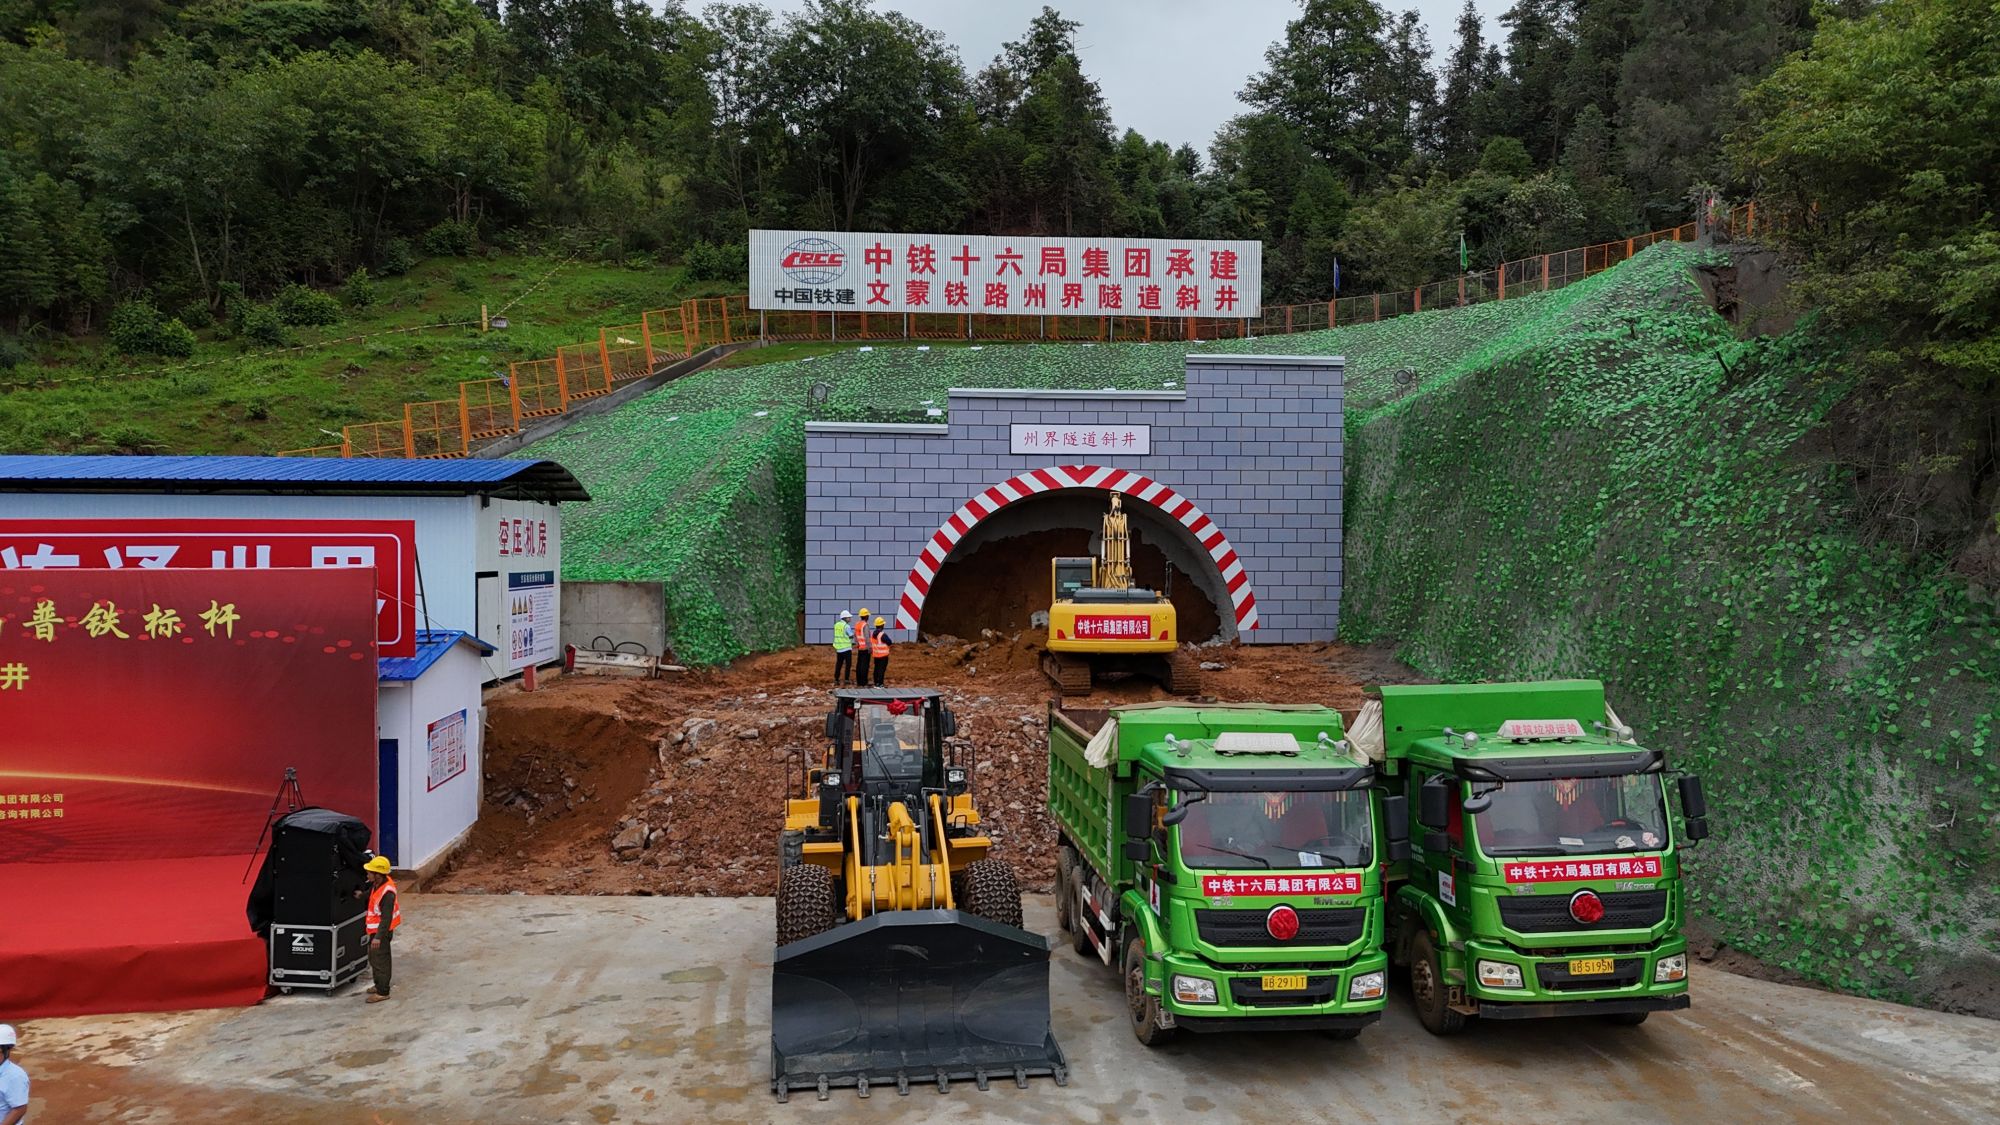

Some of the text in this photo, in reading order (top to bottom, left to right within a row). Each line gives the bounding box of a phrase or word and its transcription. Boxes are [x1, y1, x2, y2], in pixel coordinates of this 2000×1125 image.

[782, 252, 847, 268] CRCC
[864, 242, 1238, 281] 中铁十六局集团承建
[775, 288, 855, 304] 中国铁建
[866, 279, 1239, 312] 文蒙铁路州界隧道斜井
[1024, 431, 1137, 449] 州界隧道斜井
[499, 518, 546, 556] 空压机房
[0, 600, 241, 643] 普铁标杆
[1077, 619, 1148, 635] 中铁十六局集团有限公司
[1510, 861, 1657, 879] 中铁十六局集团有限公司
[1208, 877, 1357, 893] 中铁十六局集团有限公司
